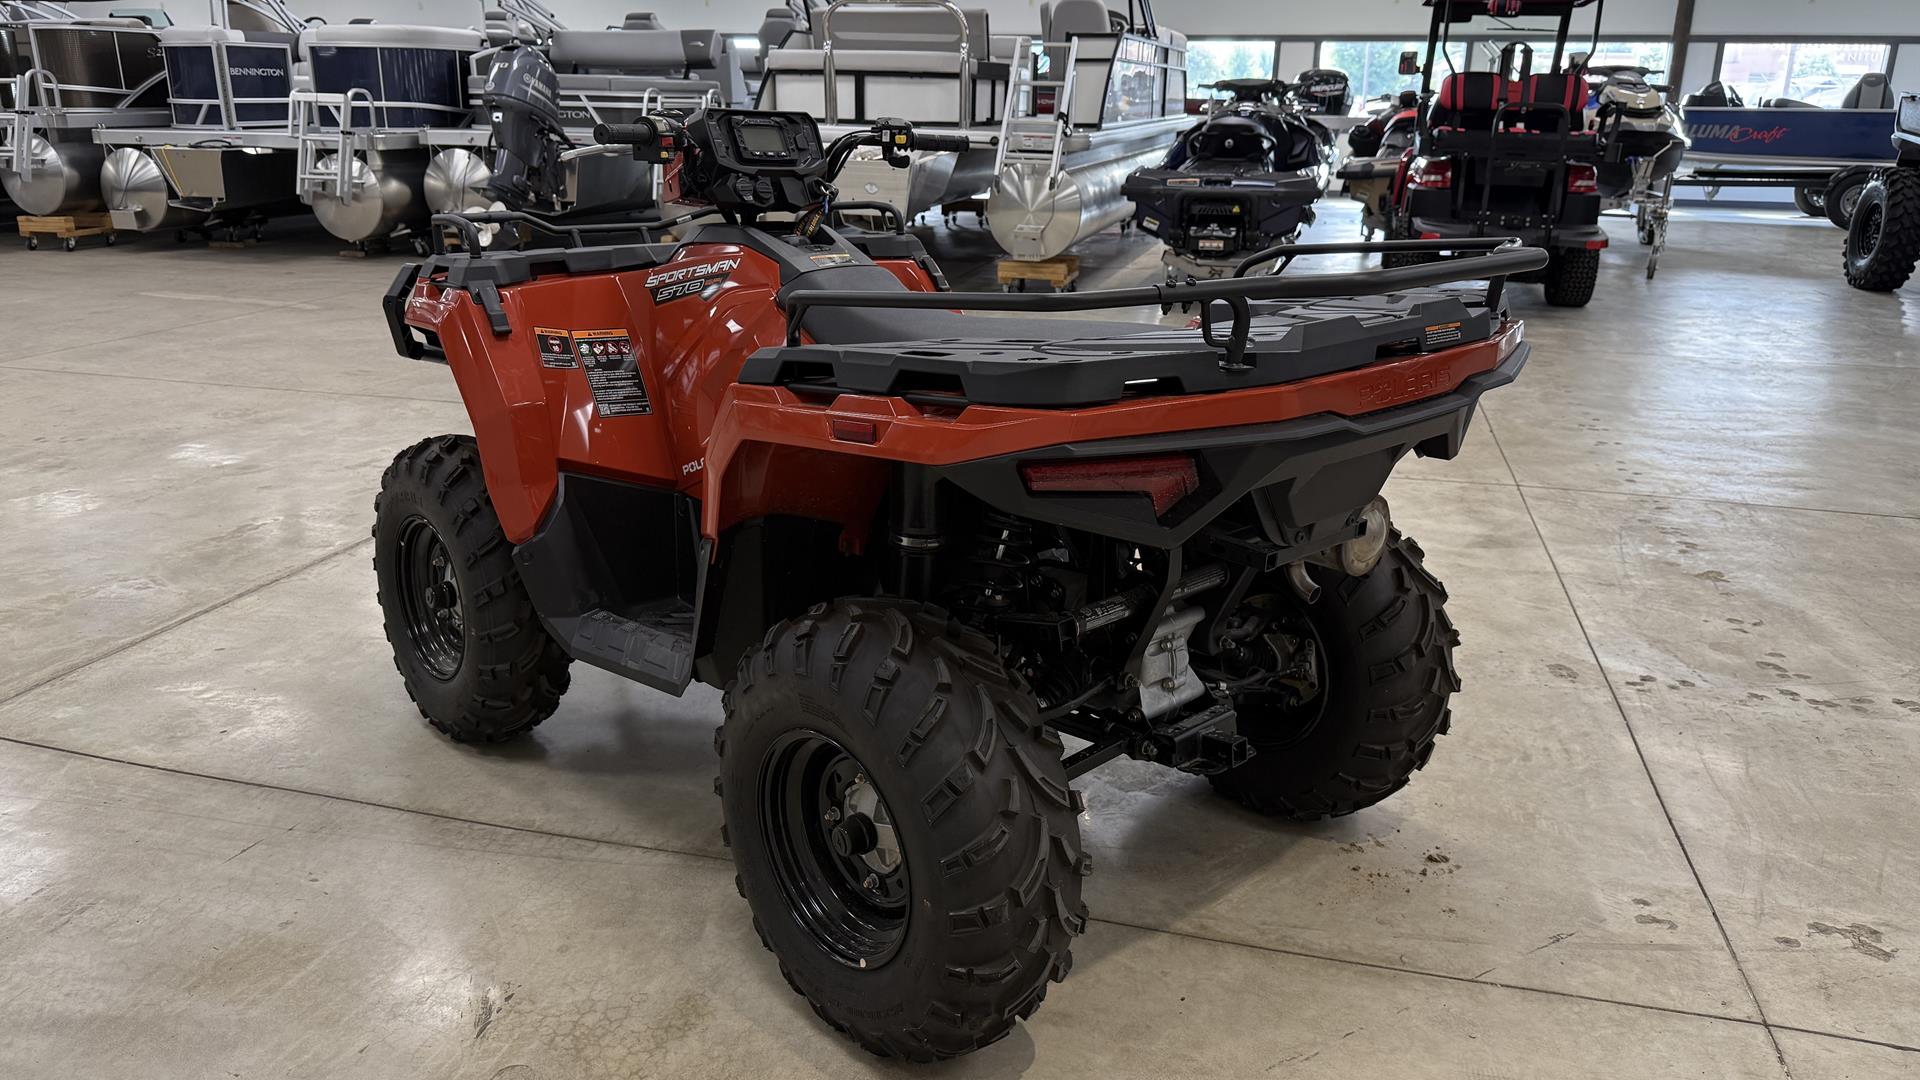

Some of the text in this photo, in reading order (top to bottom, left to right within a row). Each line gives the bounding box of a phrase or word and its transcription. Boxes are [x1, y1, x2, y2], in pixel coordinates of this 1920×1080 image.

[229, 67, 284, 77] BENNINGTON
[644, 257, 741, 288] SPORTSMAN
[656, 278, 706, 302] 570
[1360, 366, 1452, 408] POLARIS
